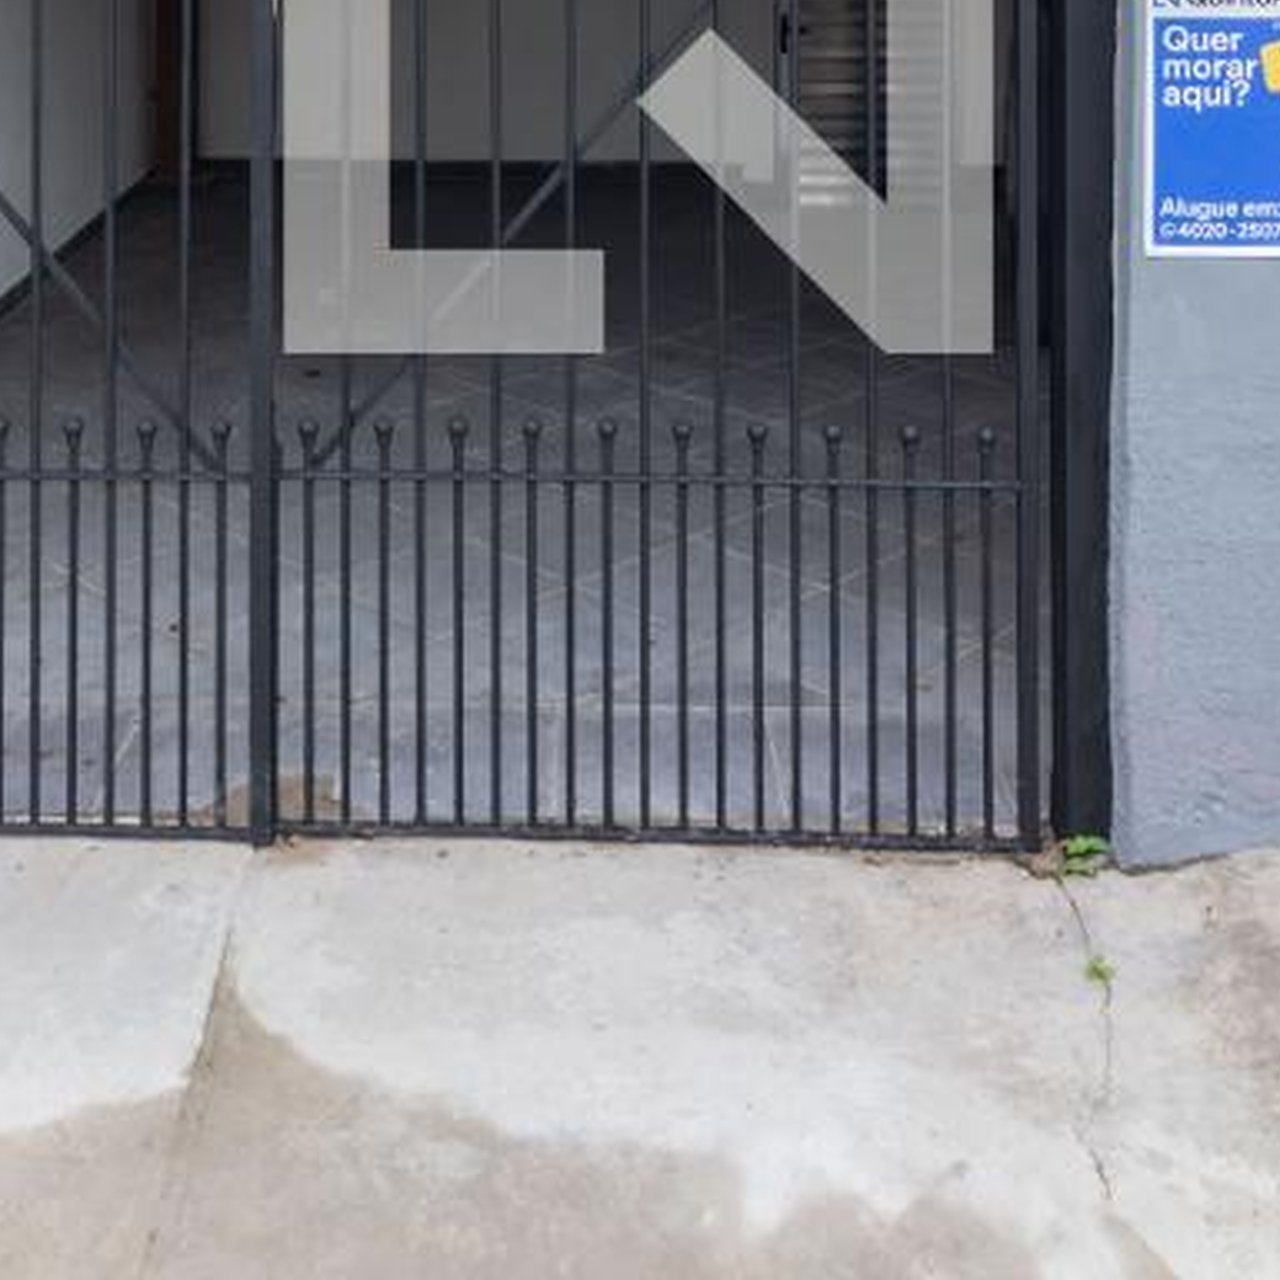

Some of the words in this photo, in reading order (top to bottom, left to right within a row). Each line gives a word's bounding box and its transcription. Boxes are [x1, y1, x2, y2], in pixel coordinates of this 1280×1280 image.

[1162, 25, 1244, 51] Quer
[1163, 57, 1258, 80] morar
[1162, 80, 1251, 113] aqui?
[1159, 196, 1238, 221] Alugue
